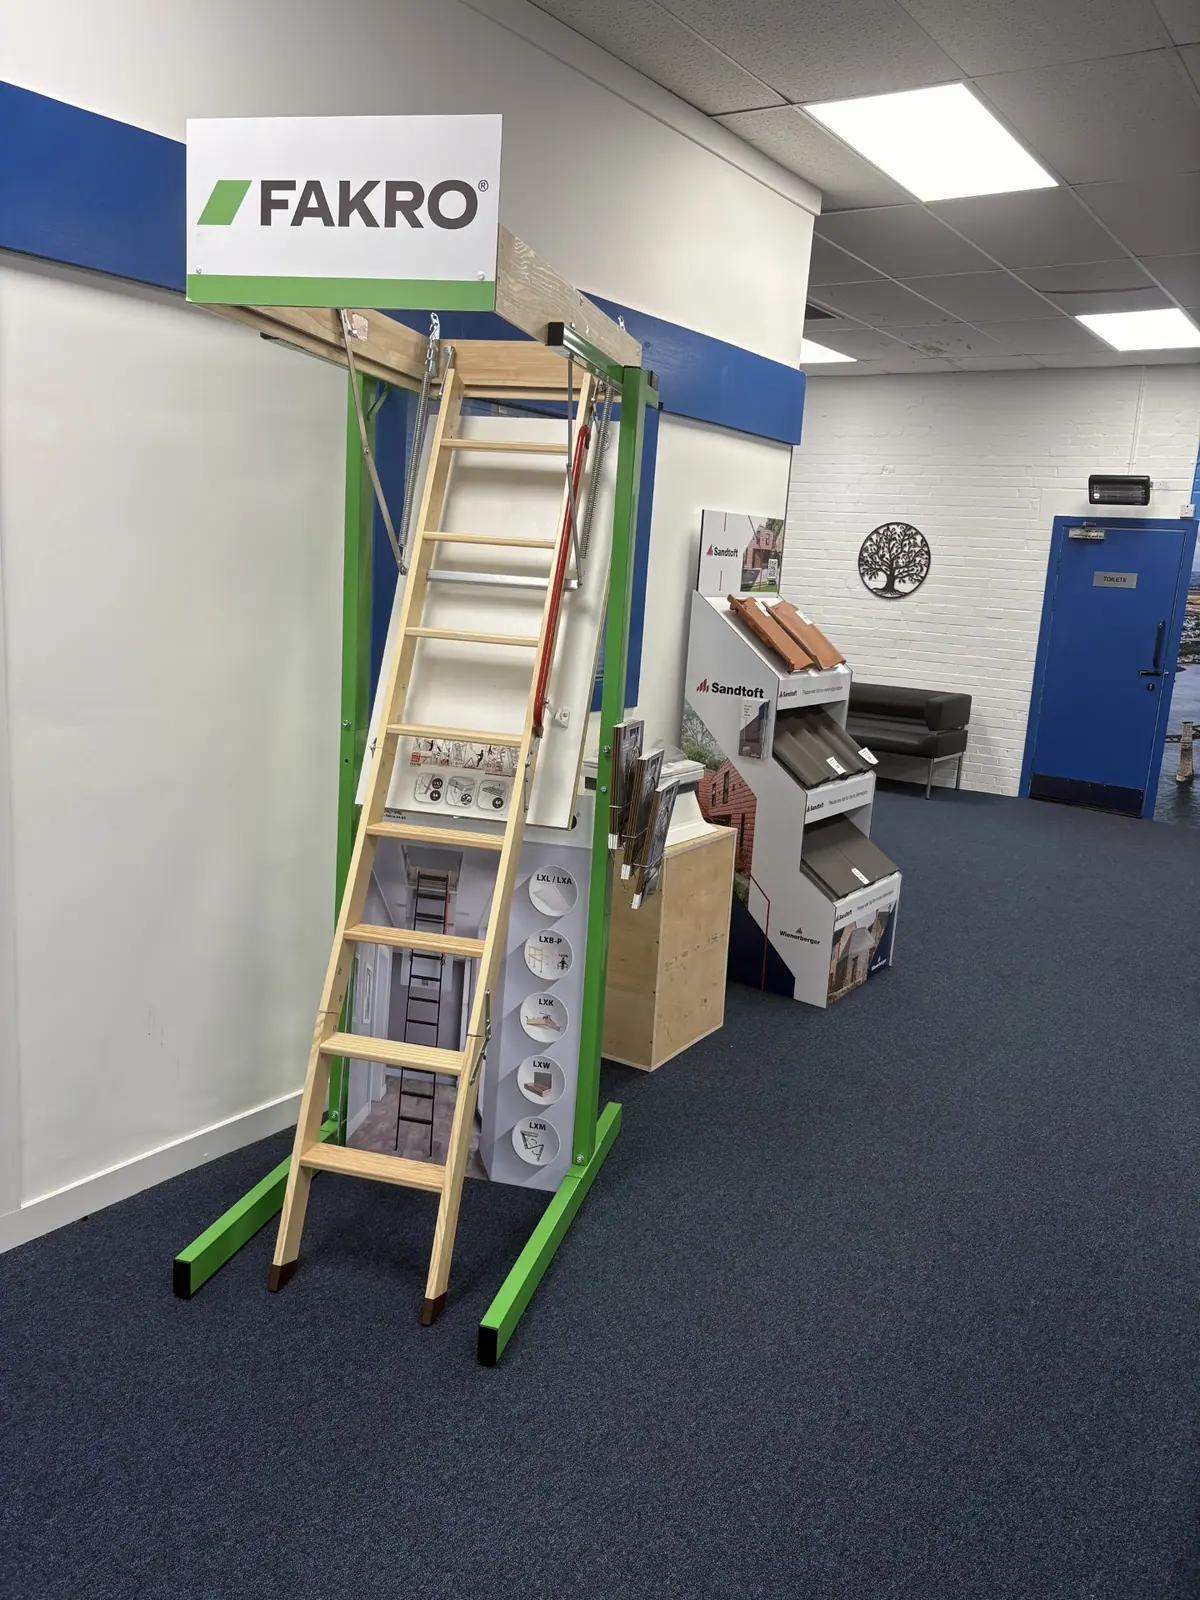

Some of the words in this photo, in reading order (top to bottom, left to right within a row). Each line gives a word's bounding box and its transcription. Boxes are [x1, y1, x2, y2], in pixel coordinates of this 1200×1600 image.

[260, 179, 478, 230] FAKRO
[713, 546, 738, 557] Sandtoft
[711, 682, 764, 698] Sandtoft
[536, 874, 551, 882] LXL
[557, 876, 572, 885] LXA
[539, 936, 562, 945] LXB-P
[780, 930, 820, 945] Wienerberger
[538, 998, 554, 1006] LXK
[533, 1061, 551, 1069] LXW
[529, 1122, 546, 1130] LXM
